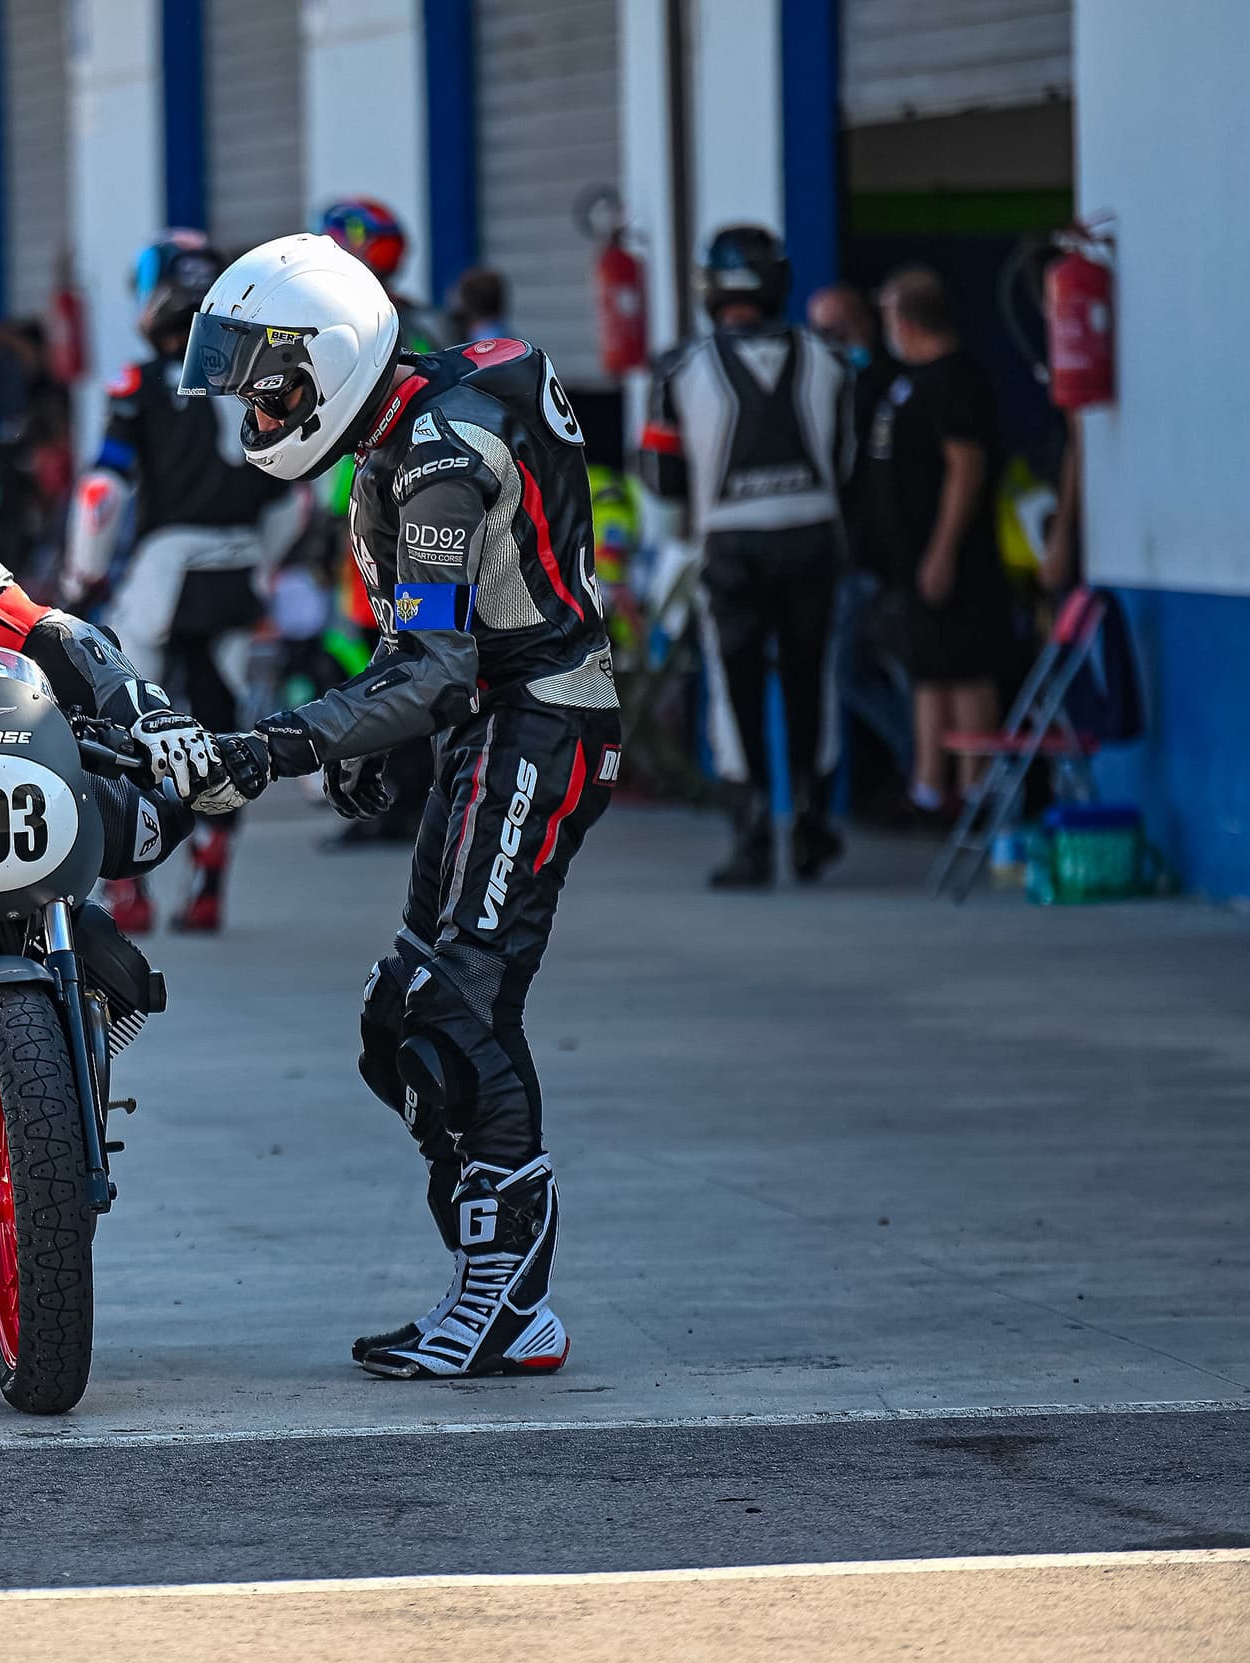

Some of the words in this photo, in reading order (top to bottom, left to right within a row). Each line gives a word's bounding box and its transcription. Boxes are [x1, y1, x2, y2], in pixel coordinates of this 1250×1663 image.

[270, 330, 296, 342] BER
[365, 397, 402, 447] VIRCOS
[393, 457, 470, 494] VIRCOS
[405, 522, 466, 550] DD92
[438, 553, 463, 563] CORSE
[477, 756, 539, 931] VIRCOS
[459, 1198, 500, 1248] G
